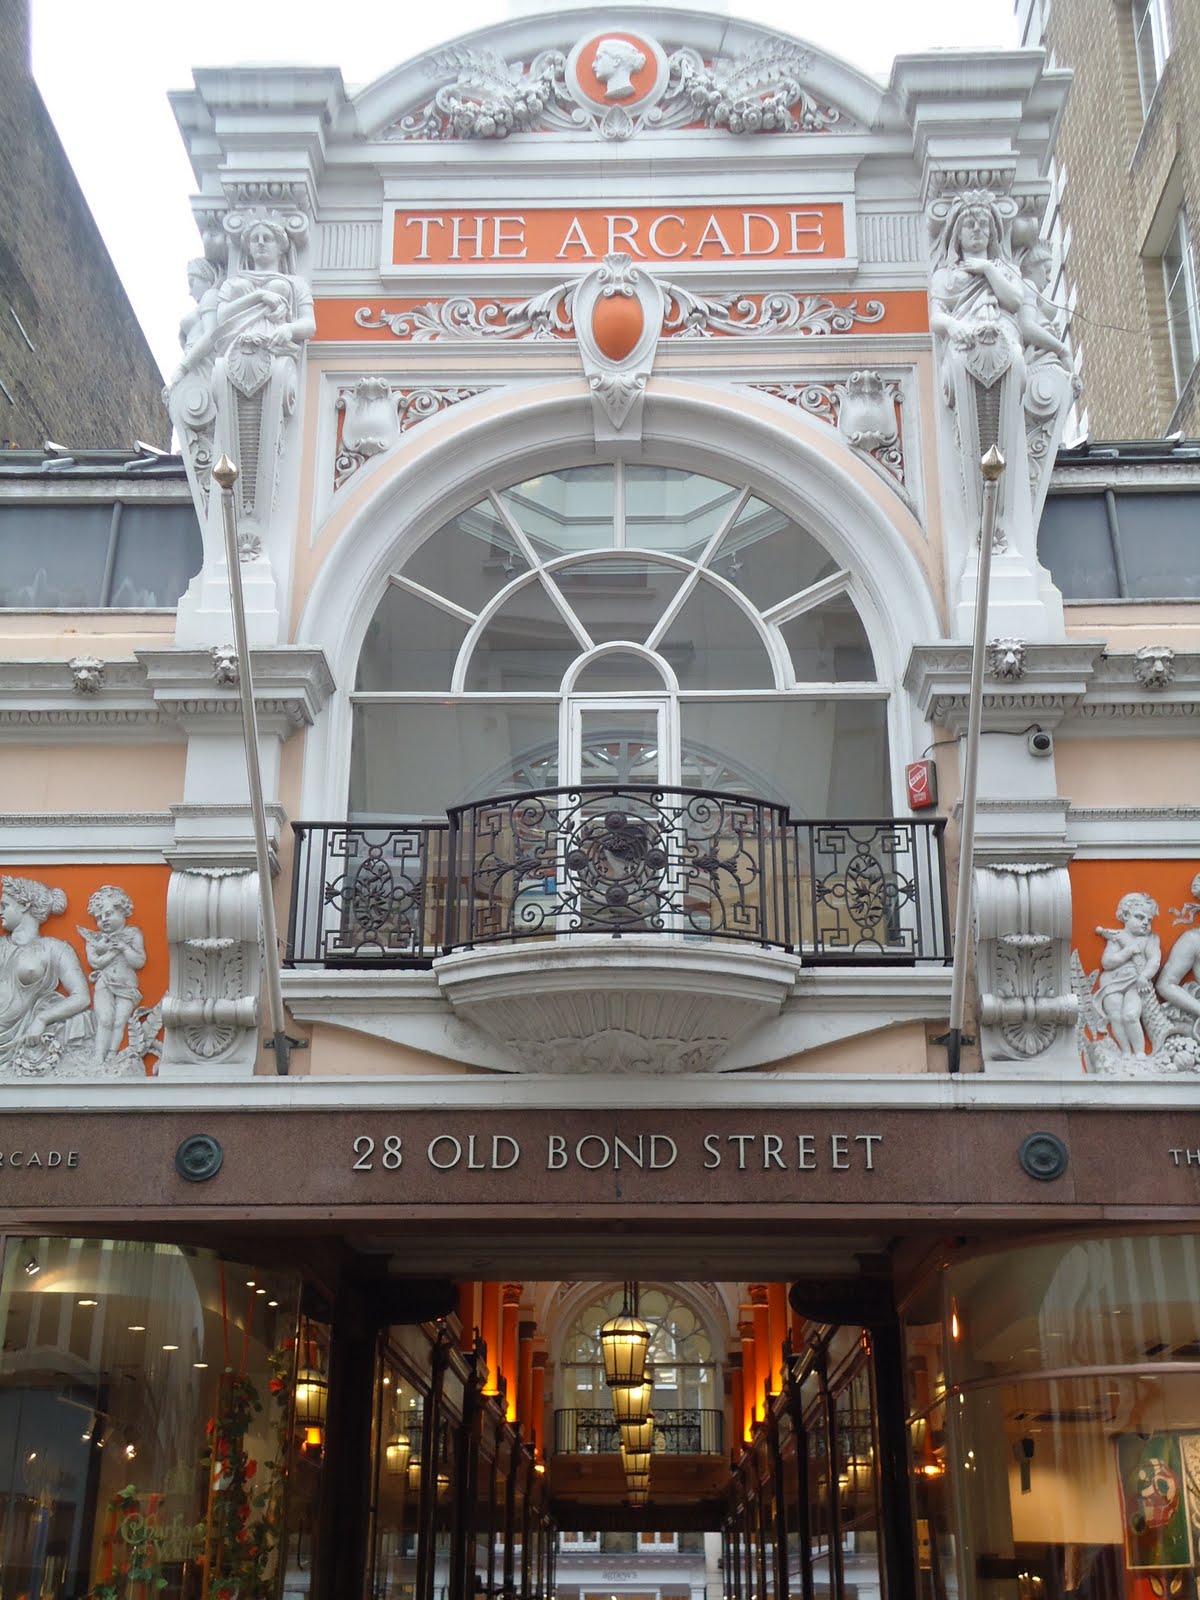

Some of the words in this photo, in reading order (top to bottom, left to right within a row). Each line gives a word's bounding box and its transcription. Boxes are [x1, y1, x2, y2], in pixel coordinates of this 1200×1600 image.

[406, 216, 528, 259] THE
[555, 210, 825, 258] ARCADE
[353, 1136, 402, 1170] 28
[427, 1135, 520, 1169] OLD
[546, 1135, 678, 1169] BOND
[703, 1134, 883, 1169] STREET
